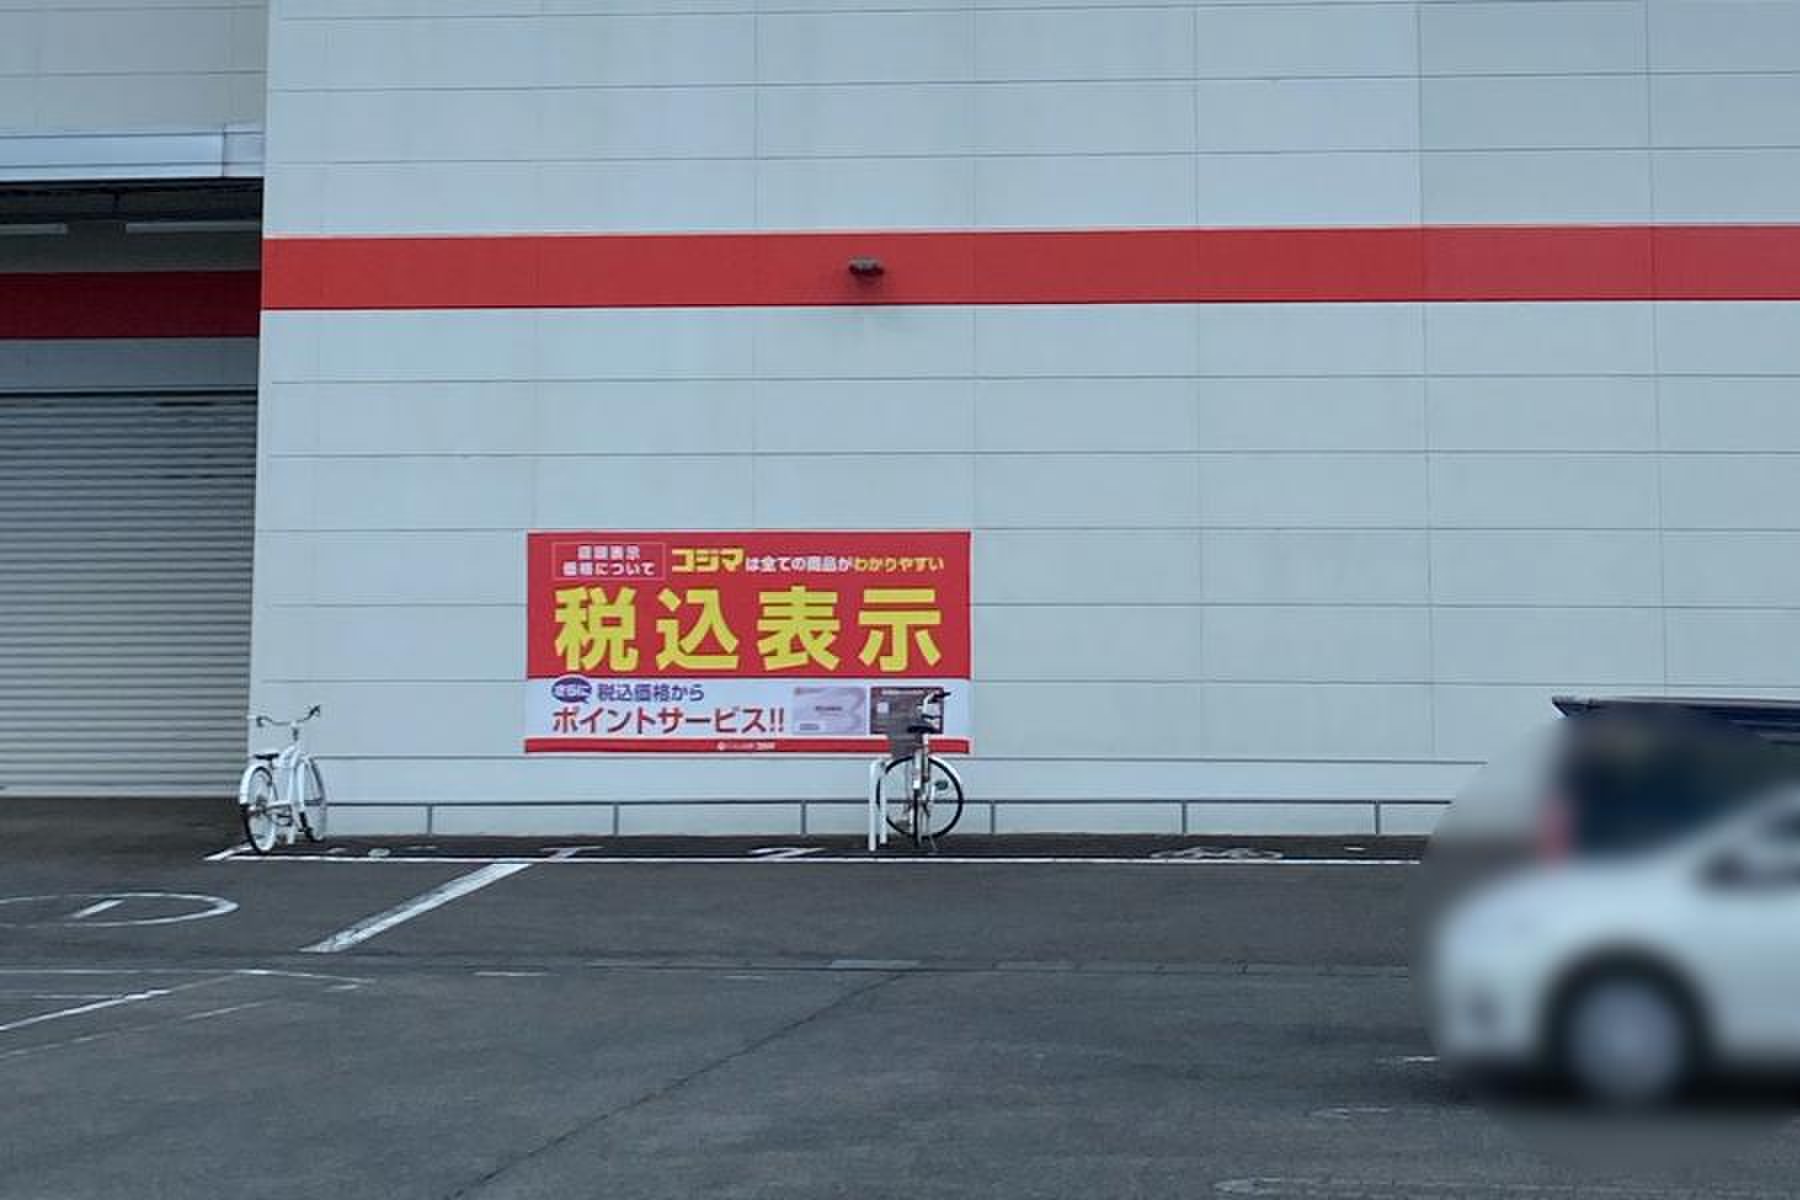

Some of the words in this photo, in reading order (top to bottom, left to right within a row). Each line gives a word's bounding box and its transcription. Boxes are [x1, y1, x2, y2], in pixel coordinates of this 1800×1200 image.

[553, 585, 942, 673] 税込表示
[597, 683, 705, 702] 税込価格から
